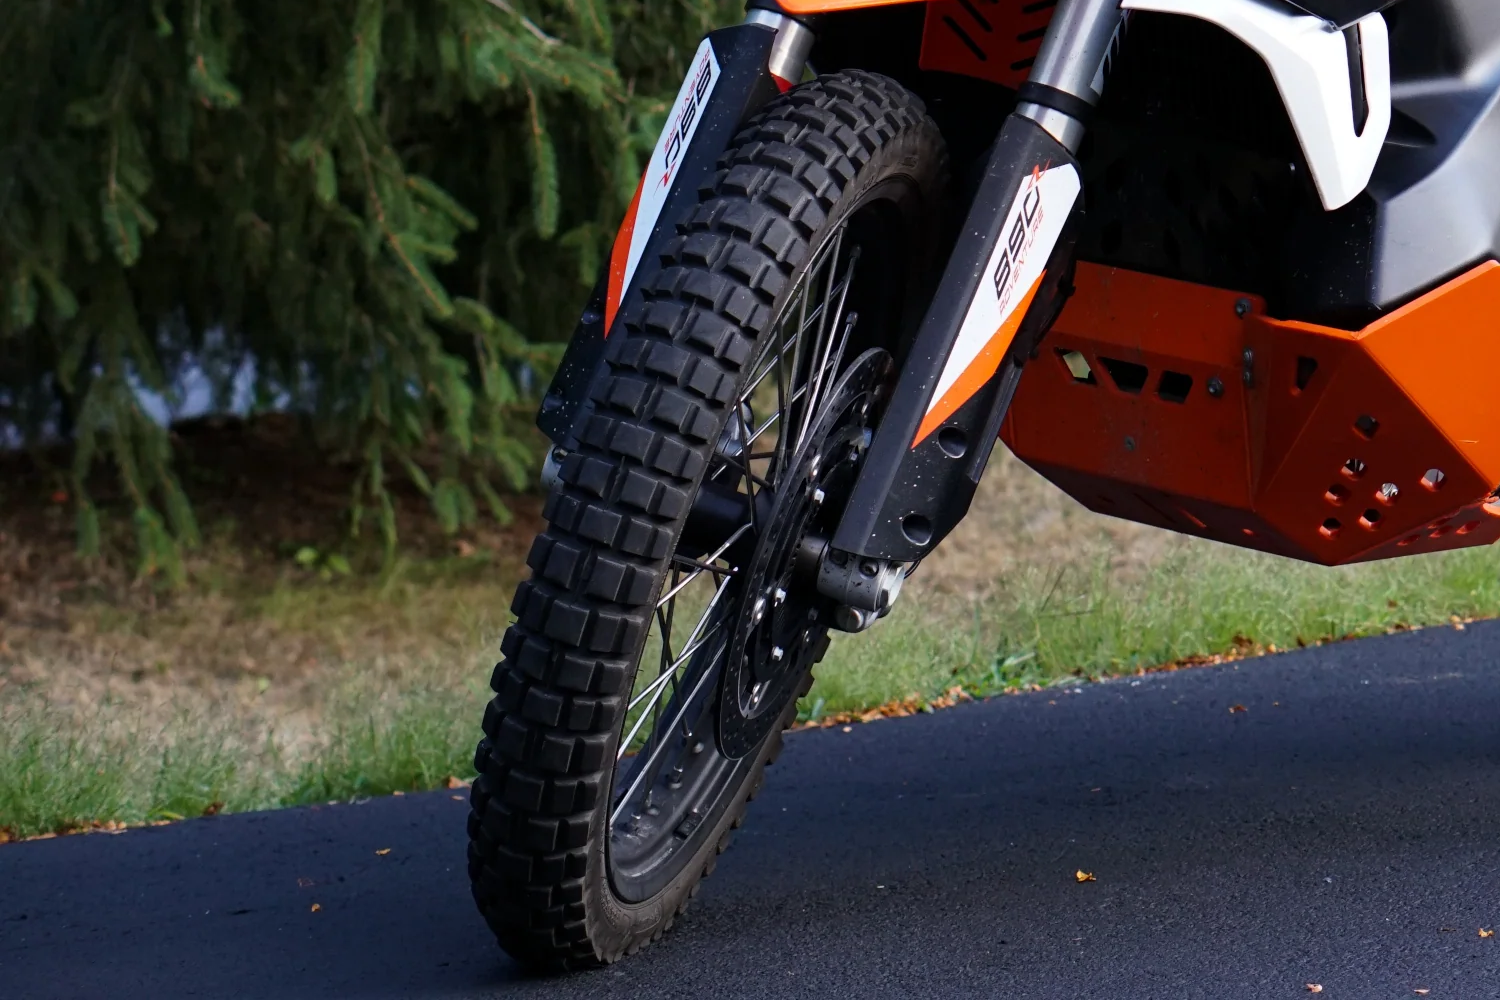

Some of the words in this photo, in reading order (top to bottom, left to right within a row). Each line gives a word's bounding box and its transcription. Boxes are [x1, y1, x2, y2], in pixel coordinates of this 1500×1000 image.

[665, 59, 711, 170] 890
[994, 185, 1040, 301] 890
[999, 205, 1044, 315] ADVENTURE
